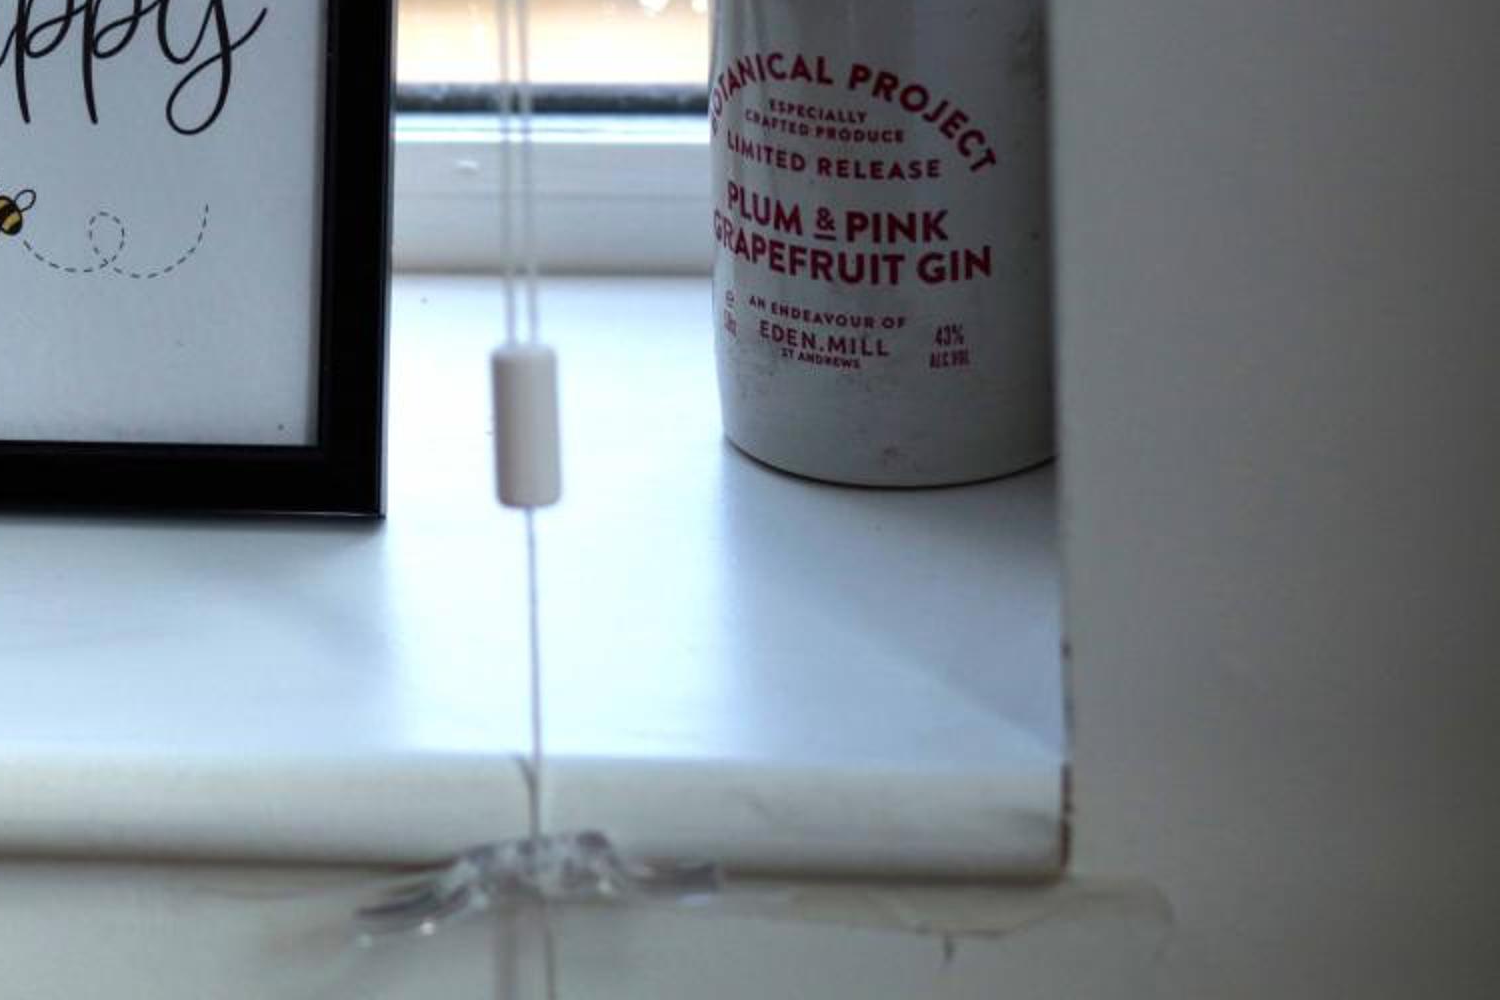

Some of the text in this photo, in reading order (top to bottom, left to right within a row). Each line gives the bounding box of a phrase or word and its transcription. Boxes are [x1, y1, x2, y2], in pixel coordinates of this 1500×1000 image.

[745, 108, 905, 144] CRAFTED PRODUCE
[769, 99, 868, 125] ESPECIALLY
[848, 63, 997, 173] PROJECT
[727, 129, 941, 180] LIMITED RELEASE
[727, 180, 949, 244] PLUM & PINK
[713, 208, 993, 286] GRAPEFRUIT GIN
[749, 296, 906, 329] AN ENDEAVOUR OF
[798, 352, 861, 370] ANDREWS
